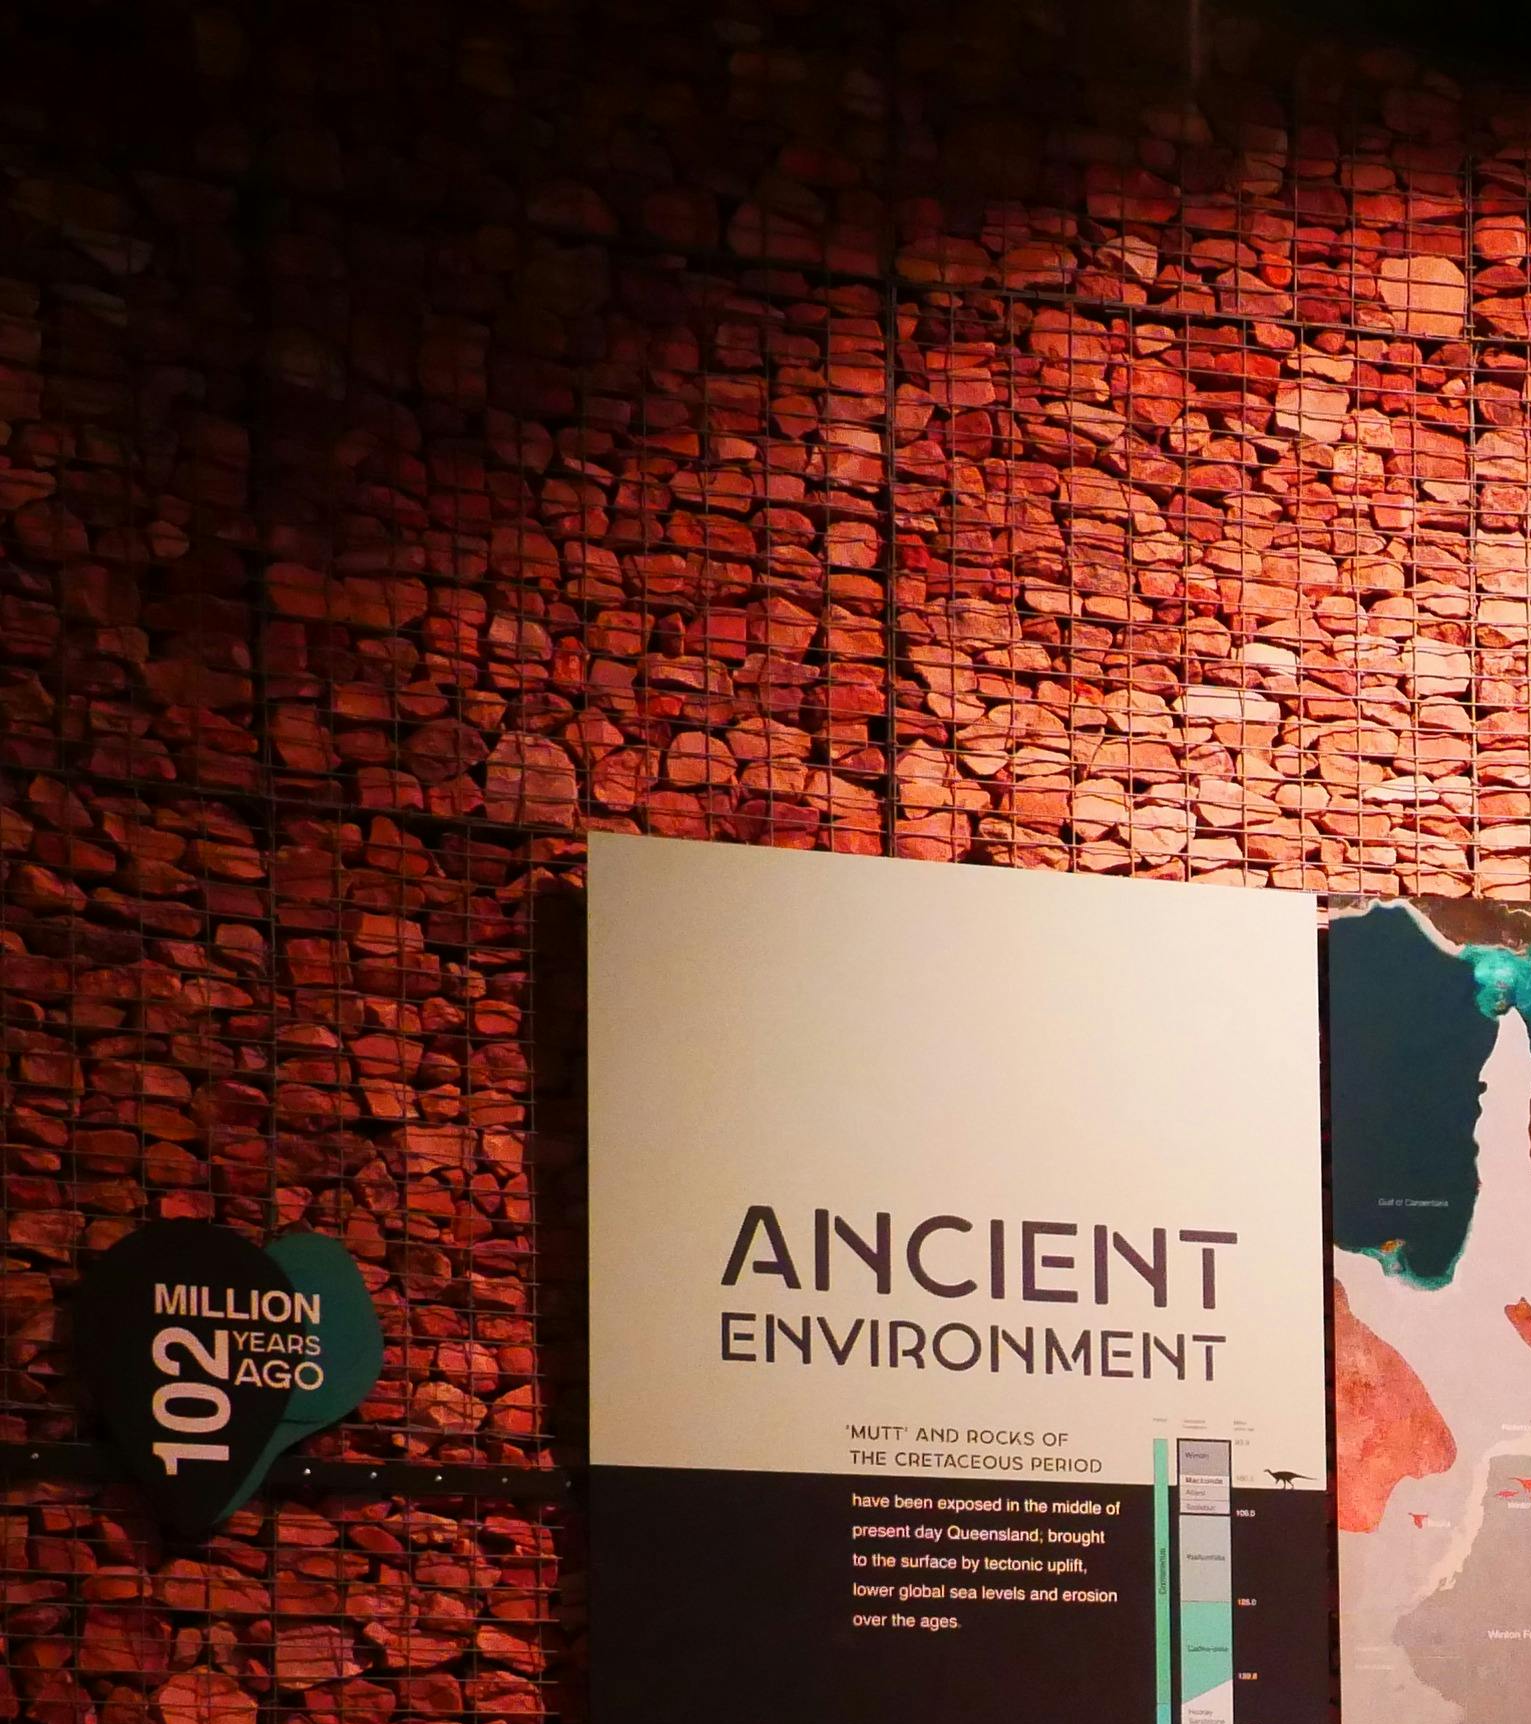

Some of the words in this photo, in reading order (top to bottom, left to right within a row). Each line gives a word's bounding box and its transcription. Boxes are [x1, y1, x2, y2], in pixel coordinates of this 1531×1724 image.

[721, 1204, 1238, 1310] ANCIENT
[154, 1283, 321, 1324] MILLION
[232, 1331, 321, 1356] YEARS
[721, 1311, 1226, 1381] ENVIRONMENT
[234, 1358, 324, 1390] AGO
[151, 1326, 231, 1475] 102
[915, 1426, 959, 1444] AND
[966, 1428, 1035, 1447] ROCKS
[1042, 1431, 1069, 1448] OF
[849, 1449, 887, 1467] THE
[894, 1450, 1024, 1472] CRETACEOUS
[1030, 1456, 1102, 1474] PERIOD
[852, 1492, 890, 1509] have
[894, 1494, 933, 1510] been
[937, 1497, 1002, 1515] exposed
[1006, 1497, 1020, 1513] in
[1023, 1497, 1049, 1515] the
[1052, 1498, 1102, 1516] middle
[1105, 1499, 1121, 1516] of
[852, 1524, 911, 1541] present
[914, 1523, 943, 1543] day
[1047, 1527, 1106, 1548] brought
[852, 1552, 868, 1568] to
[871, 1552, 897, 1568] the
[900, 1553, 958, 1571] surface
[961, 1554, 981, 1574] by
[983, 1555, 1044, 1572] tectonic
[1047, 1557, 1088, 1576] uplift,
[852, 1581, 895, 1598] lower
[898, 1583, 945, 1603] global
[949, 1586, 978, 1600] sea
[981, 1584, 1026, 1601] levels
[1029, 1586, 1059, 1603] and
[1061, 1588, 1118, 1604] erosion
[852, 1614, 888, 1628] over
[891, 1612, 917, 1629] the
[919, 1615, 962, 1633] ages.
[1488, 1629, 1521, 1639] Winton
